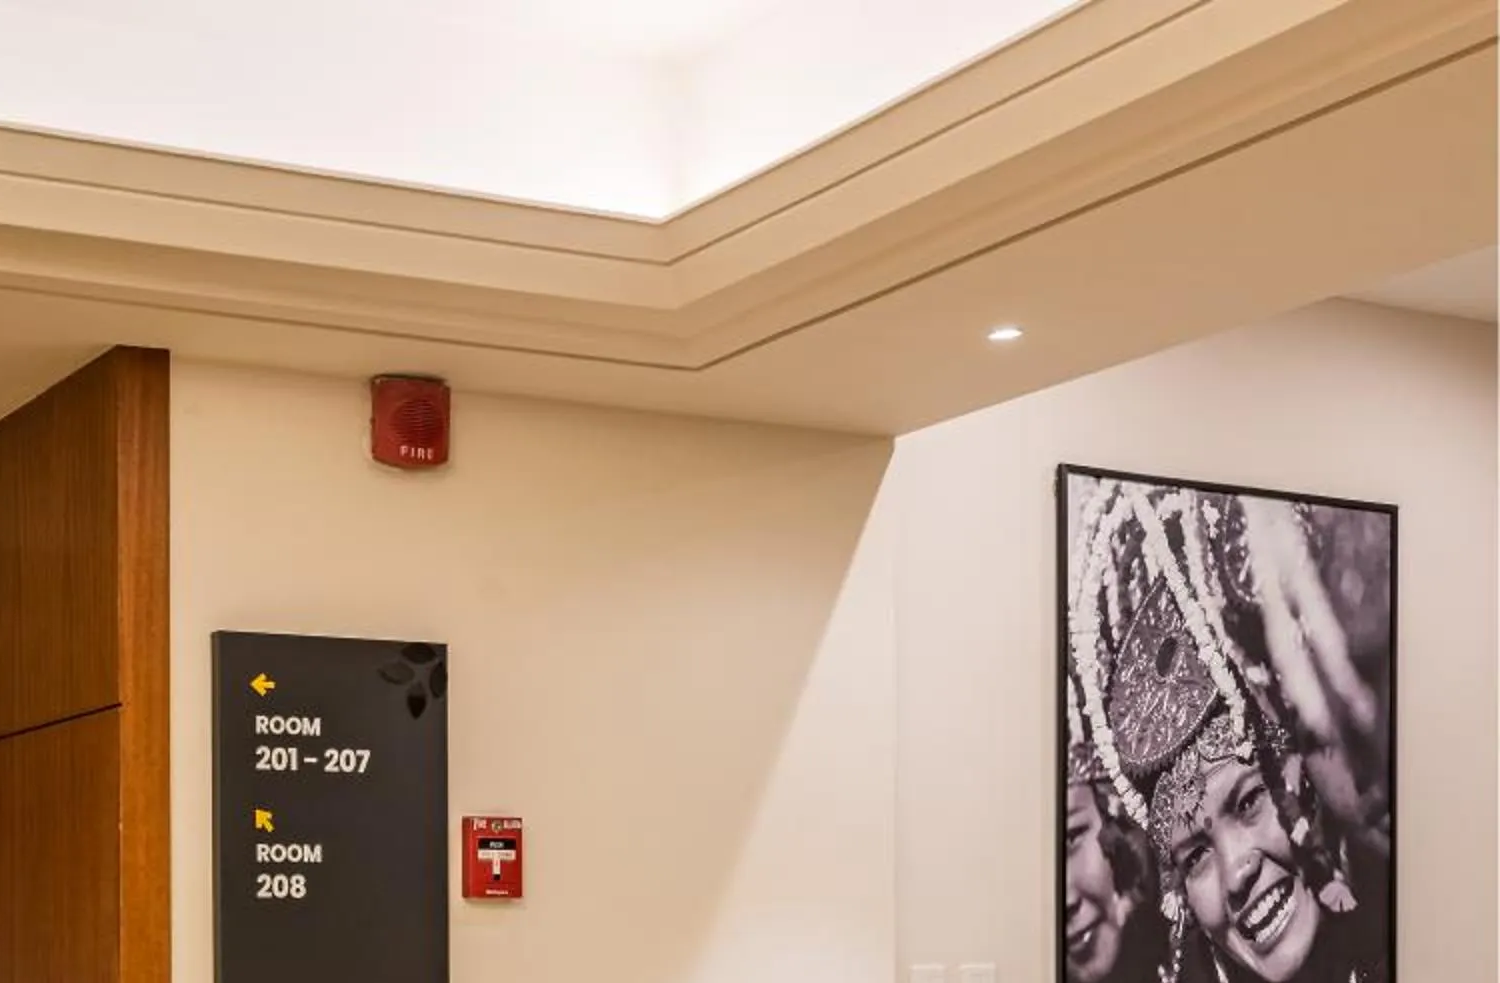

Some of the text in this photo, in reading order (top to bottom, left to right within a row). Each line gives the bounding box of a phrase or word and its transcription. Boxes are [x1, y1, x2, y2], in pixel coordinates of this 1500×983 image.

[400, 445, 434, 460] FIRE
[255, 715, 322, 736] ROOM
[255, 745, 299, 771] 201
[323, 748, 371, 773] 207
[256, 843, 323, 863] ROOM
[256, 874, 307, 899] 208
